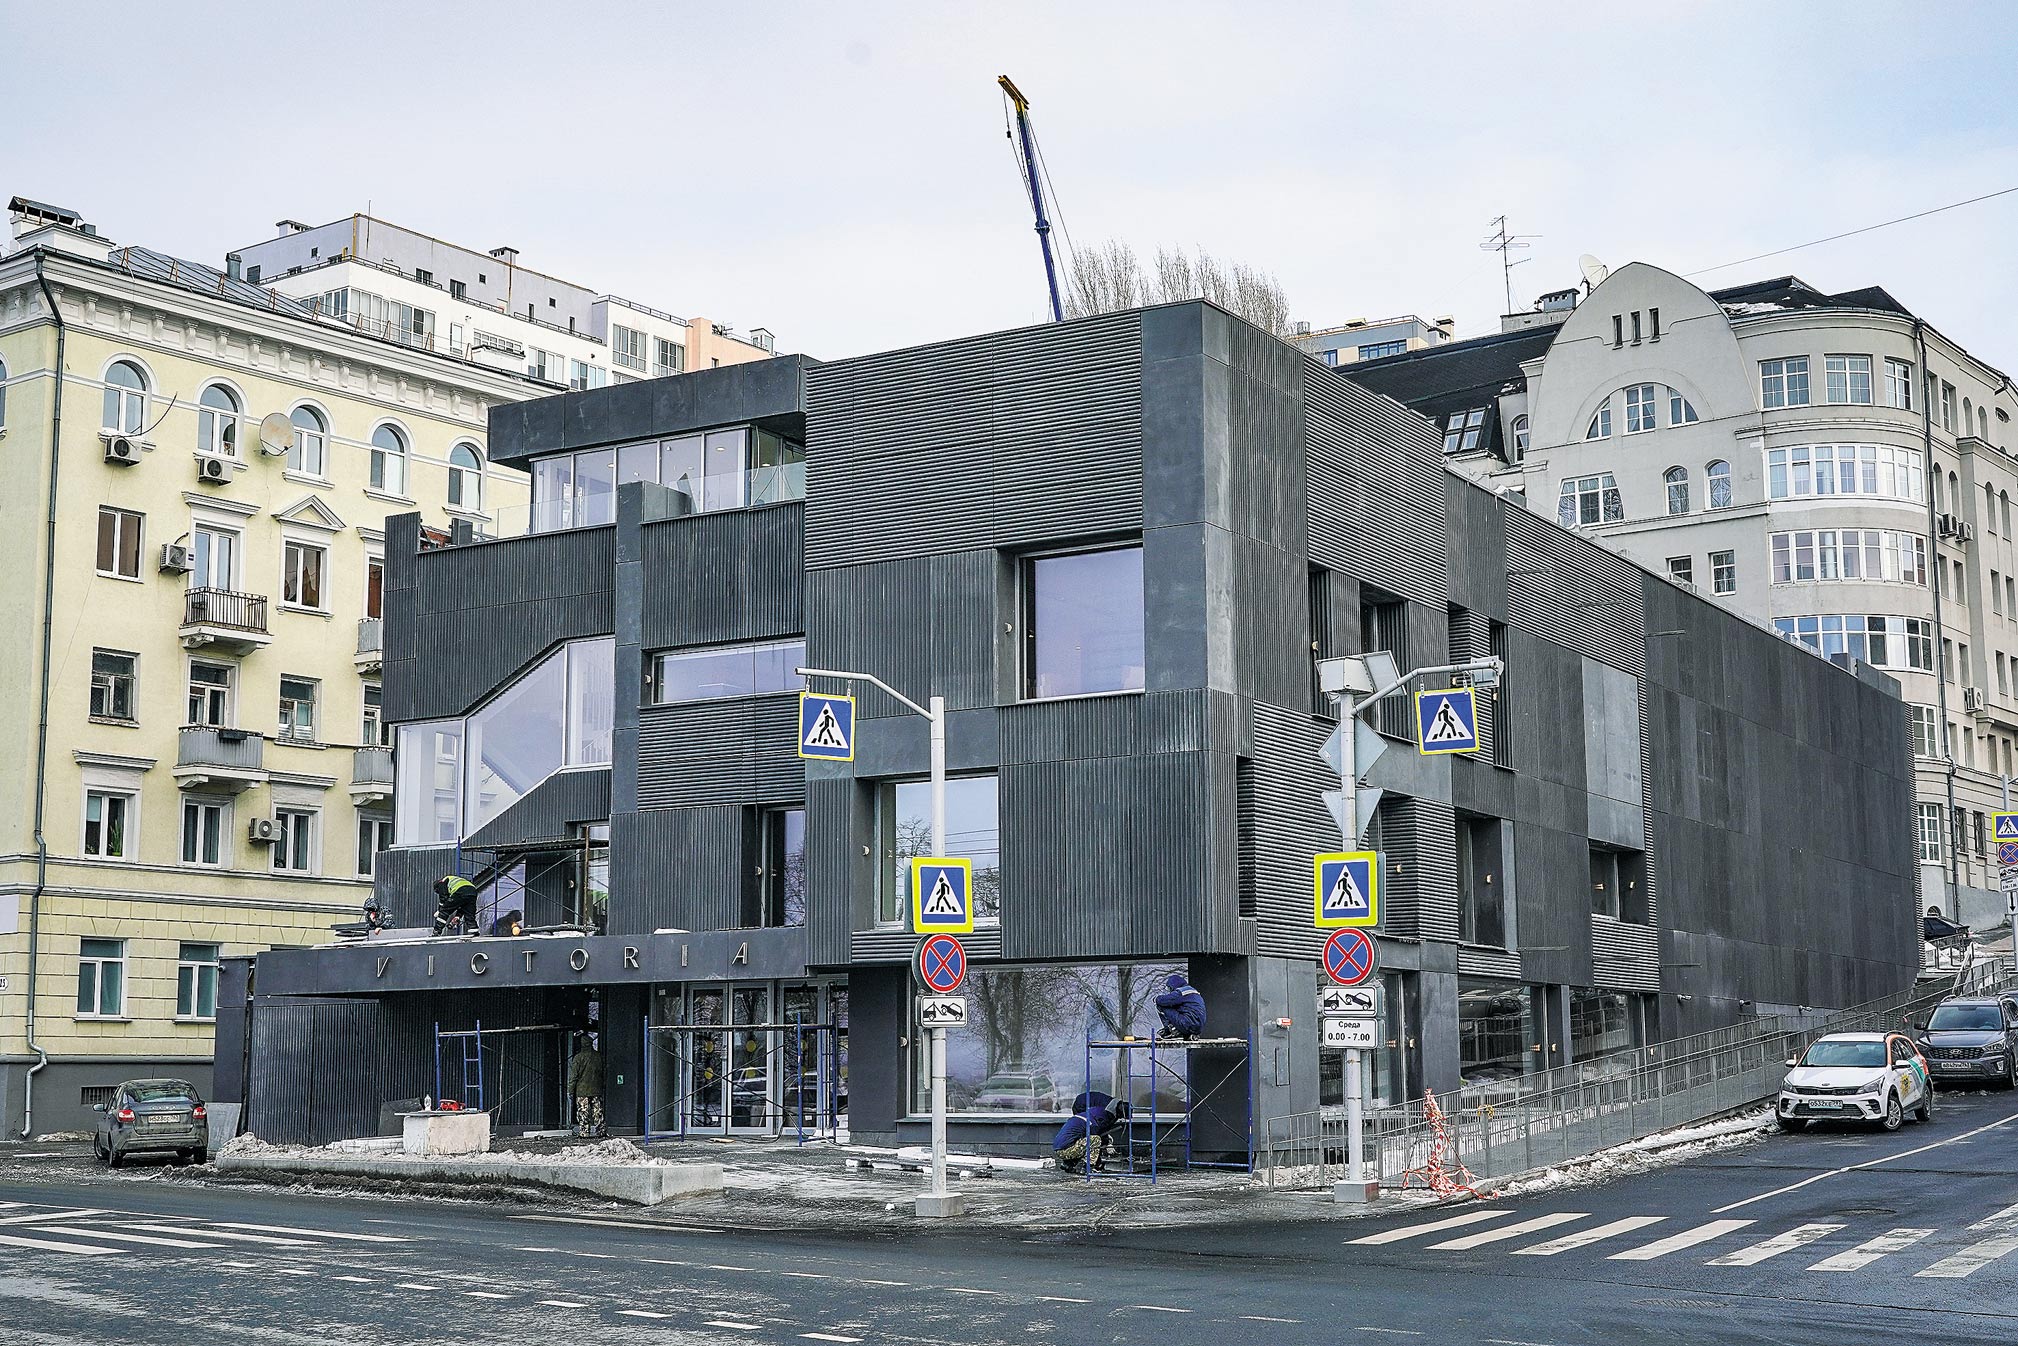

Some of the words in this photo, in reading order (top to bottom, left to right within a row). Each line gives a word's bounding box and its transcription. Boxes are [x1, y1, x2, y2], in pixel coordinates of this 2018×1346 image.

[375, 941, 749, 978] VICTORIA
[1338, 1021, 1360, 1029] Среда
[1328, 1032, 1346, 1040] 0.00
[1352, 1033, 1370, 1041] 7.00
